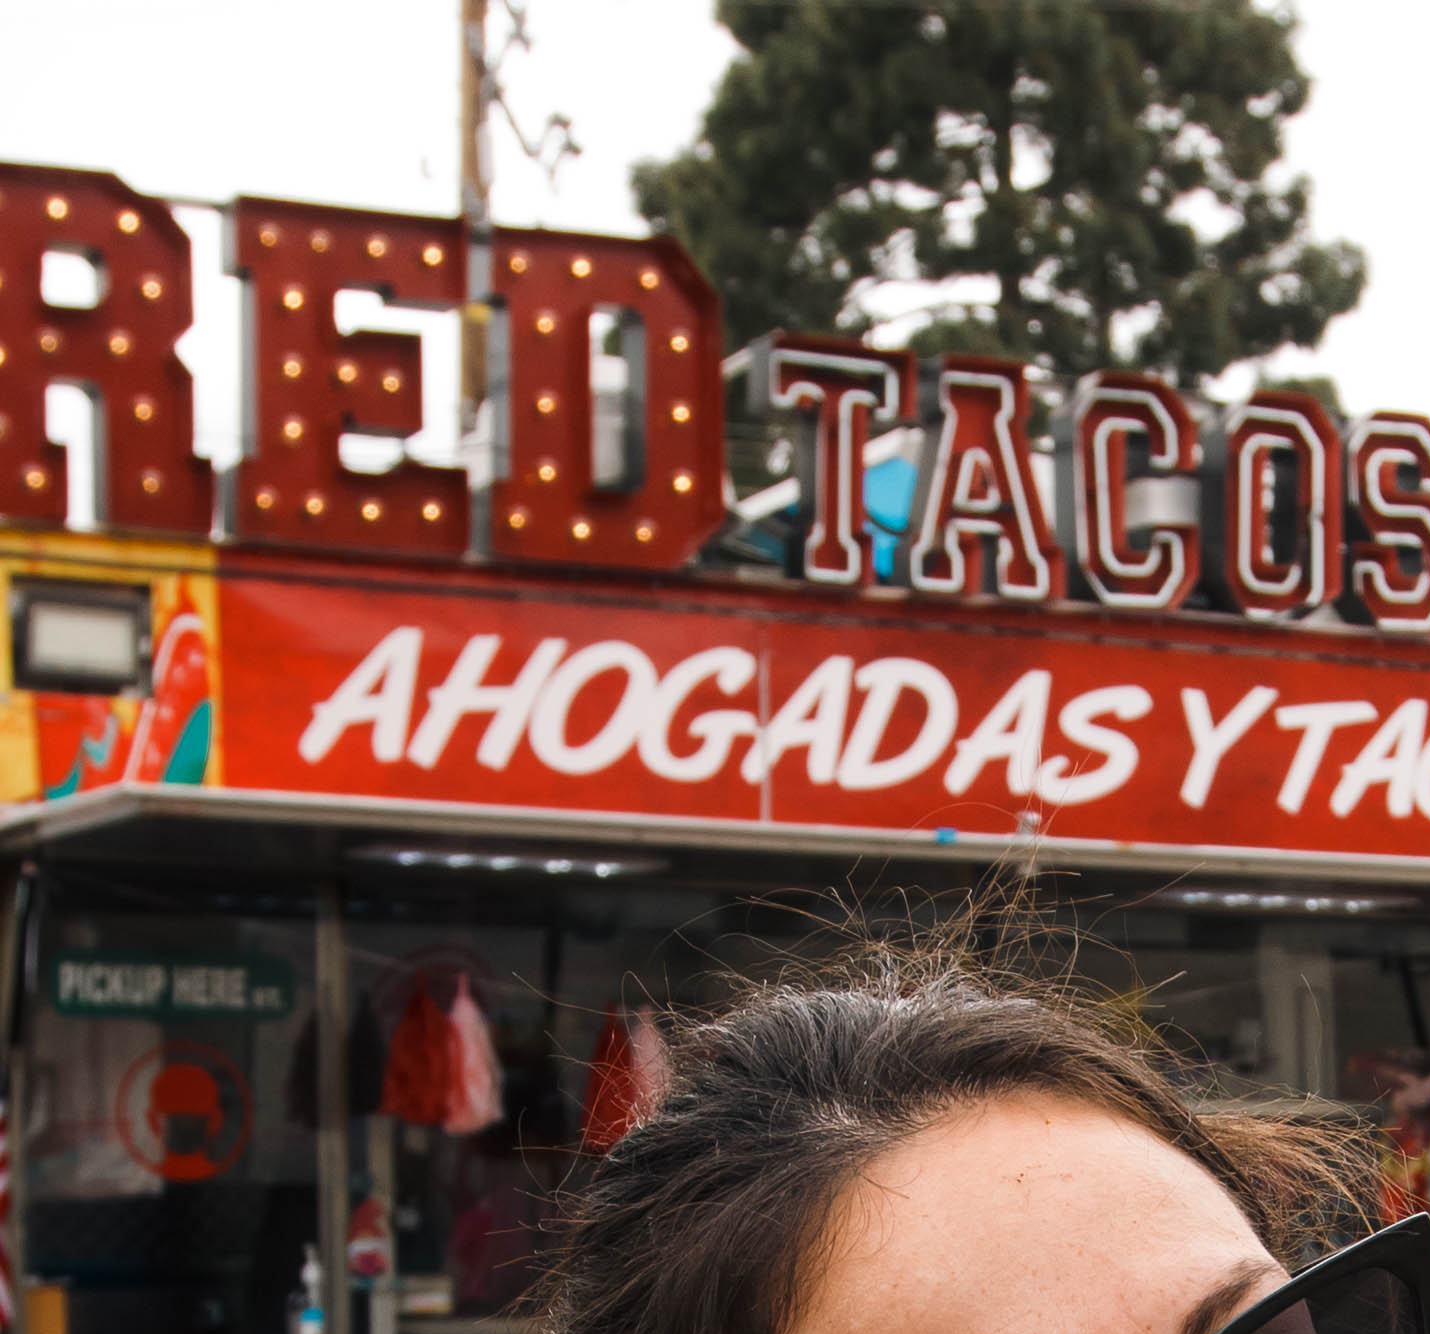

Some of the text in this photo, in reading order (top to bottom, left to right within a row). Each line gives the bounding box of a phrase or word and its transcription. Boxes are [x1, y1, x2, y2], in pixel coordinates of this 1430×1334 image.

[0, 162, 724, 569] RED
[297, 626, 1152, 806] AHOGADAS
[1179, 686, 1280, 810] Y
